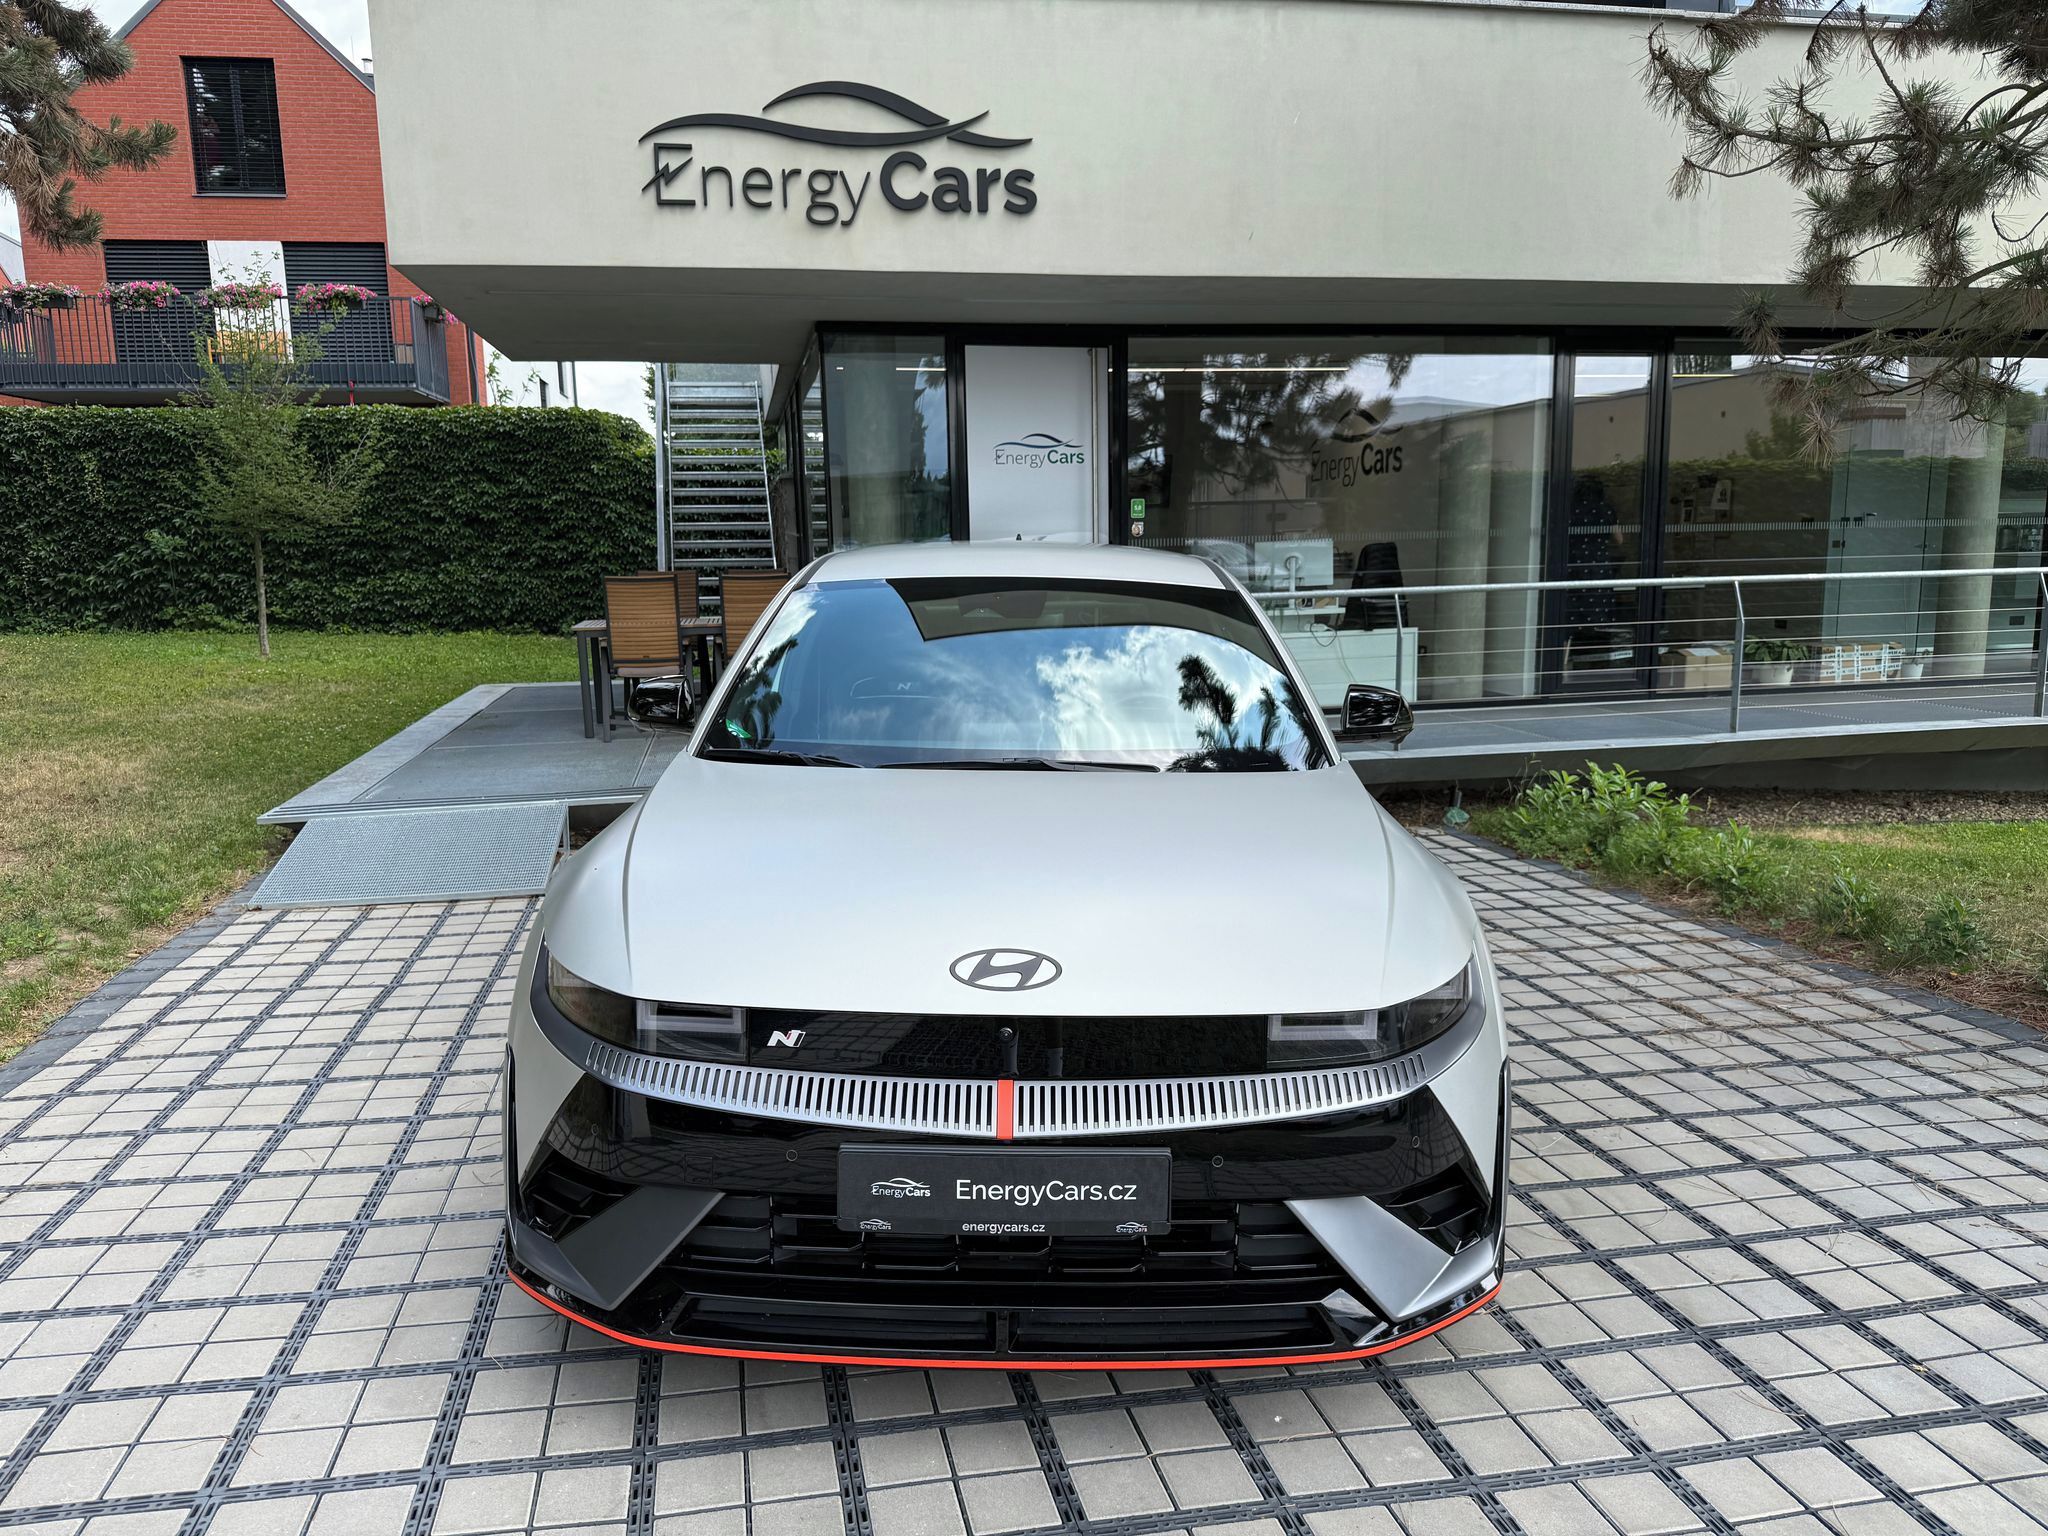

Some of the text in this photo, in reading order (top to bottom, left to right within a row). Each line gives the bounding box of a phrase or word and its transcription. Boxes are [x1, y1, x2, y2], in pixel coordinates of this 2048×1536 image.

[642, 143, 1037, 226] EnergyCars
[994, 449, 1085, 469] EnergyCars
[1310, 442, 1403, 488] EnergyCars
[871, 1185, 931, 1199] EnergyCars
[955, 1179, 1137, 1206] EnergyCars.cz
[962, 1221, 1046, 1234] energycars.cz
